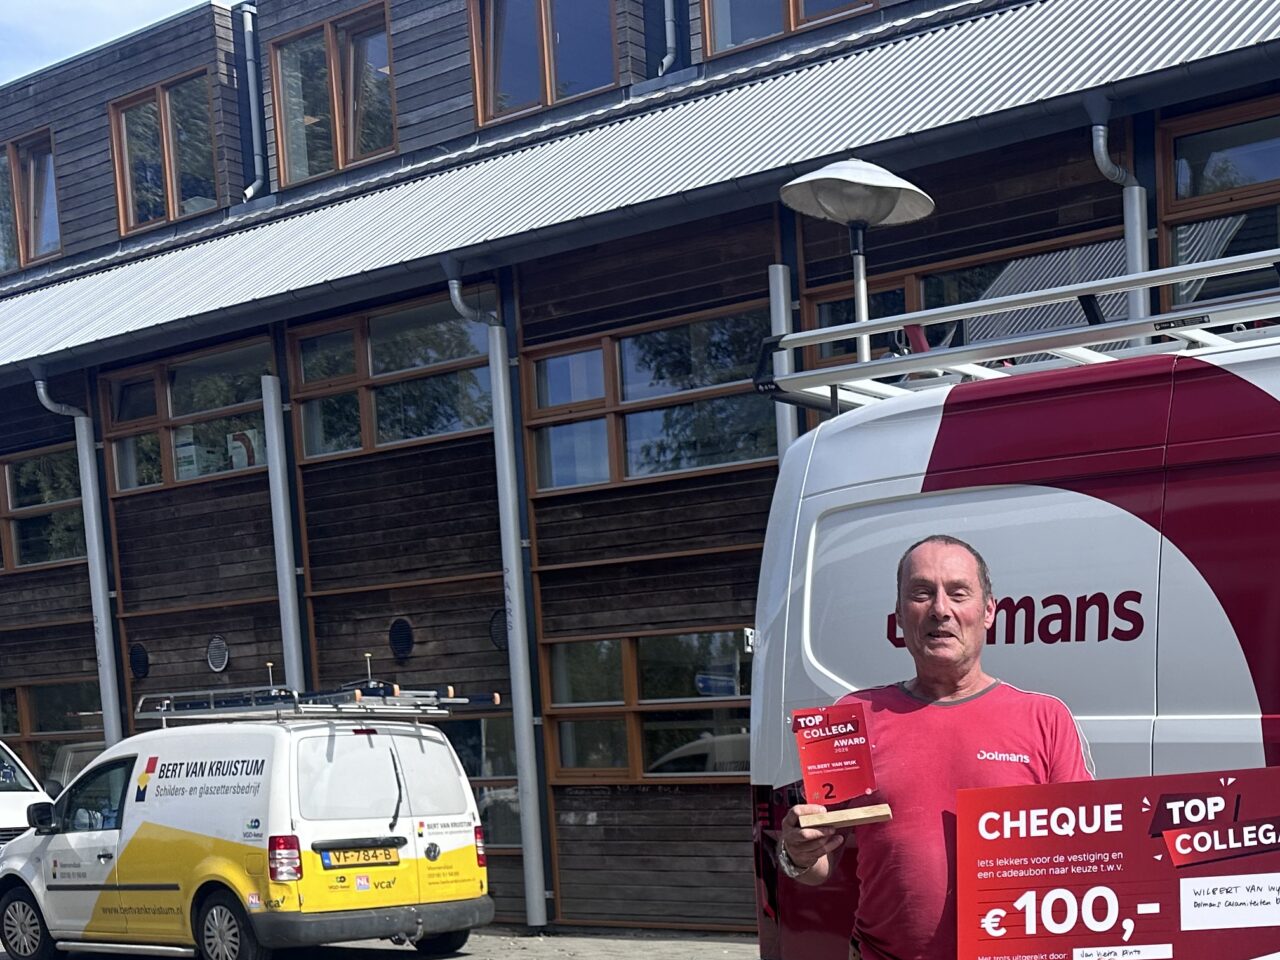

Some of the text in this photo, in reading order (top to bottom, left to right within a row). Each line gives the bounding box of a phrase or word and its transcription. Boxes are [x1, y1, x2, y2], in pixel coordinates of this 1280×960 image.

[887, 590, 1145, 649] mans
[797, 715, 824, 728] TOP
[803, 723, 855, 739] COLLEGA
[833, 736, 866, 748] AWARD
[976, 750, 1030, 764] Dolmans
[158, 759, 266, 779] BERT VAN KRUISTUM
[155, 784, 188, 797] Schilders-
[188, 786, 198, 796] en
[1166, 796, 1225, 825] TOP
[977, 803, 1123, 841] CHEQUE
[333, 849, 392, 863] VF-784-B
[977, 851, 1124, 868] Iets lekkers voor de vestiging en
[977, 863, 1124, 879] een cadeaubon naar keuze t.w.v.
[1192, 885, 1241, 896] WILBERT
[1245, 884, 1263, 894] VAN
